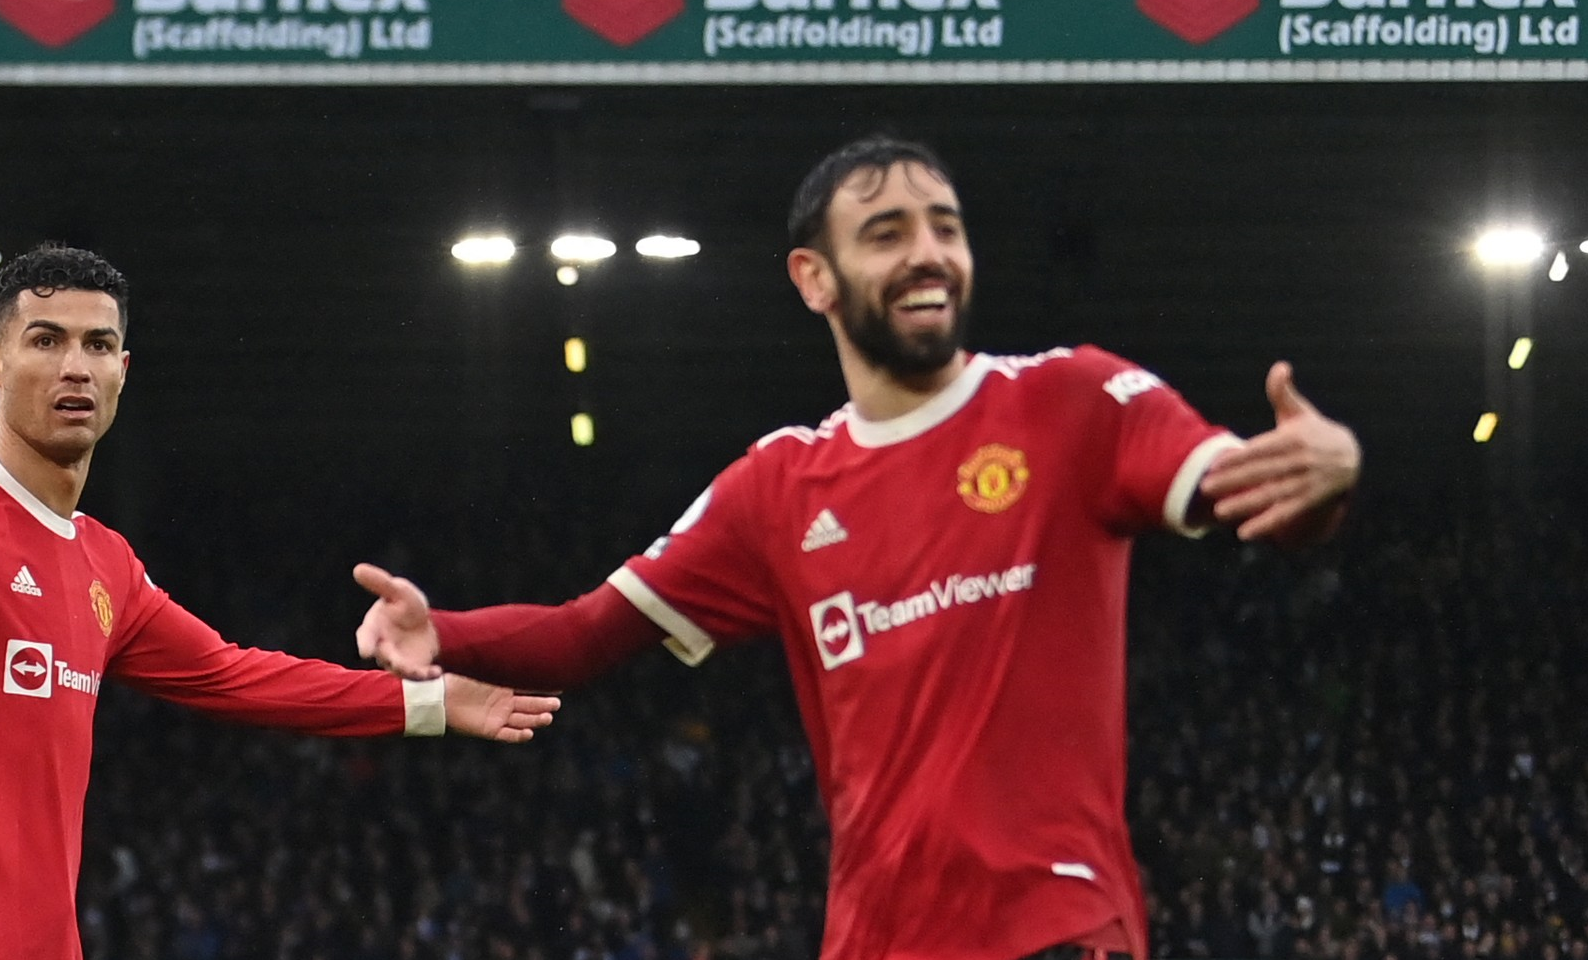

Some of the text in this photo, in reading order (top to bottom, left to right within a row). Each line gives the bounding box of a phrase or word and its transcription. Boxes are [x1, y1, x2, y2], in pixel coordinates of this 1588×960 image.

[369, 17, 432, 49] Ltd
[703, 15, 1003, 56] (Scaffolding) Ltd
[1279, 13, 1579, 54] (Scaffolding) Ltd
[856, 563, 1037, 635] TeamViewer
